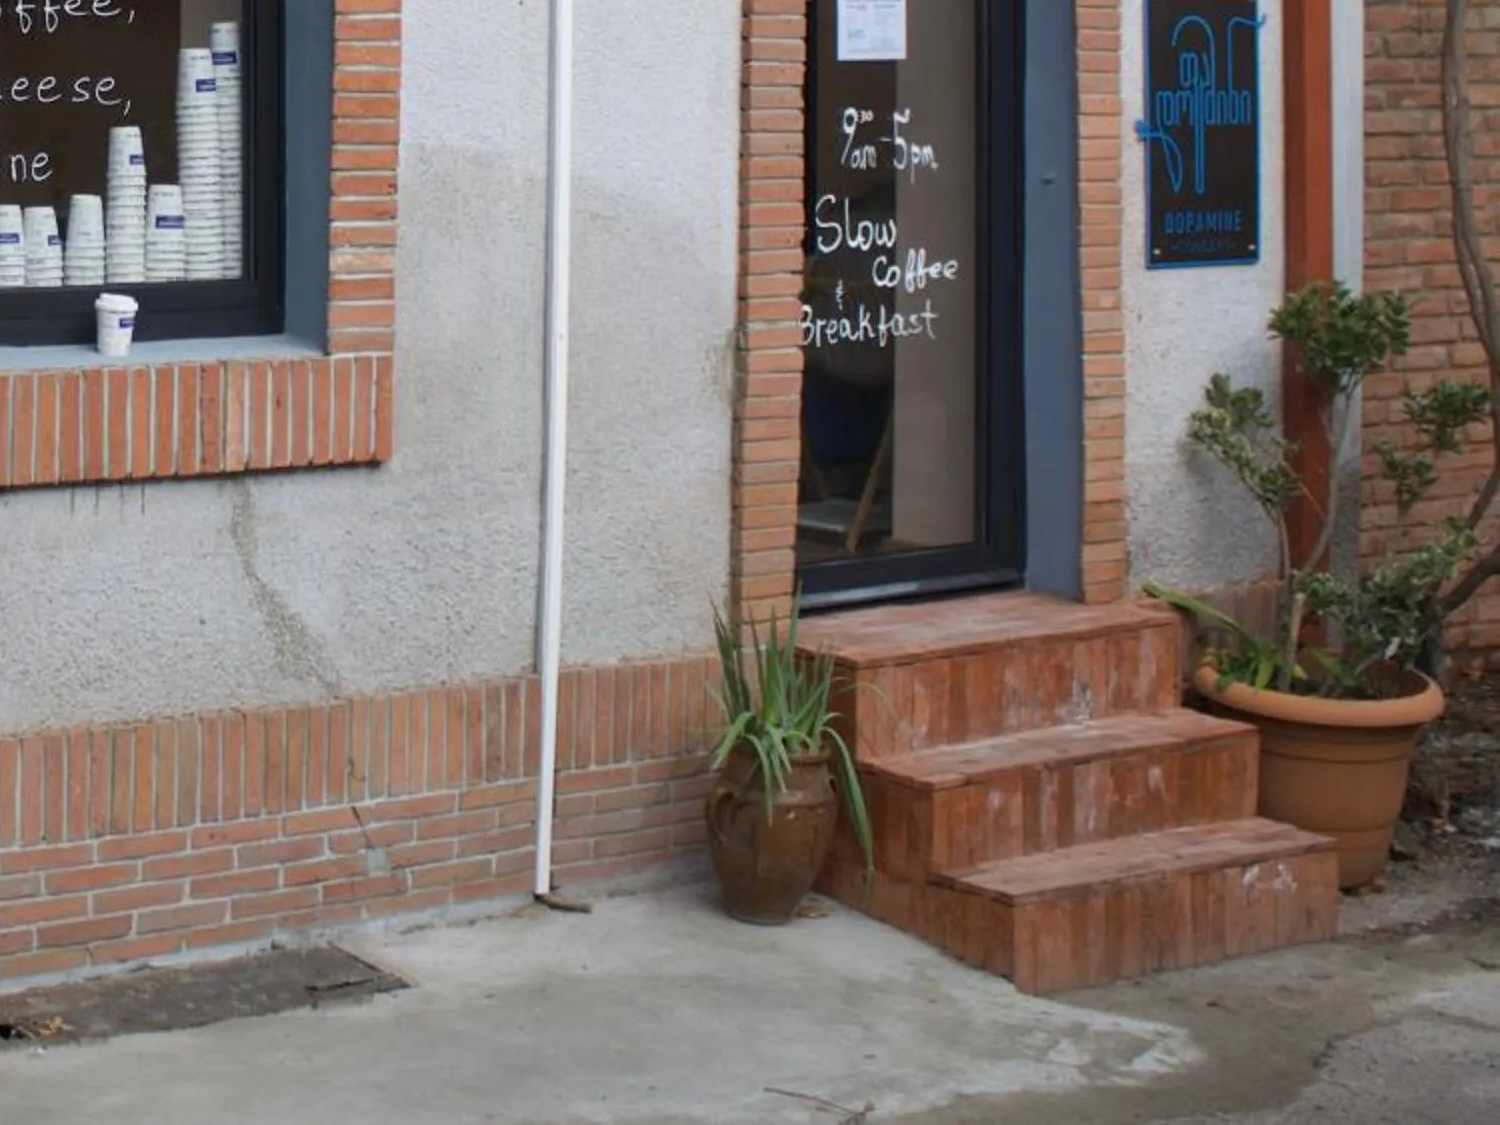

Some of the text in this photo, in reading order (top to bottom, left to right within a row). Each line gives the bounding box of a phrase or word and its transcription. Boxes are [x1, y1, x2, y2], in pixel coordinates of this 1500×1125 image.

[815, 194, 897, 253] Slow
[1165, 209, 1243, 234] DOPAMINE
[872, 248, 959, 294] Coffee
[800, 298, 938, 348] Breakfast
